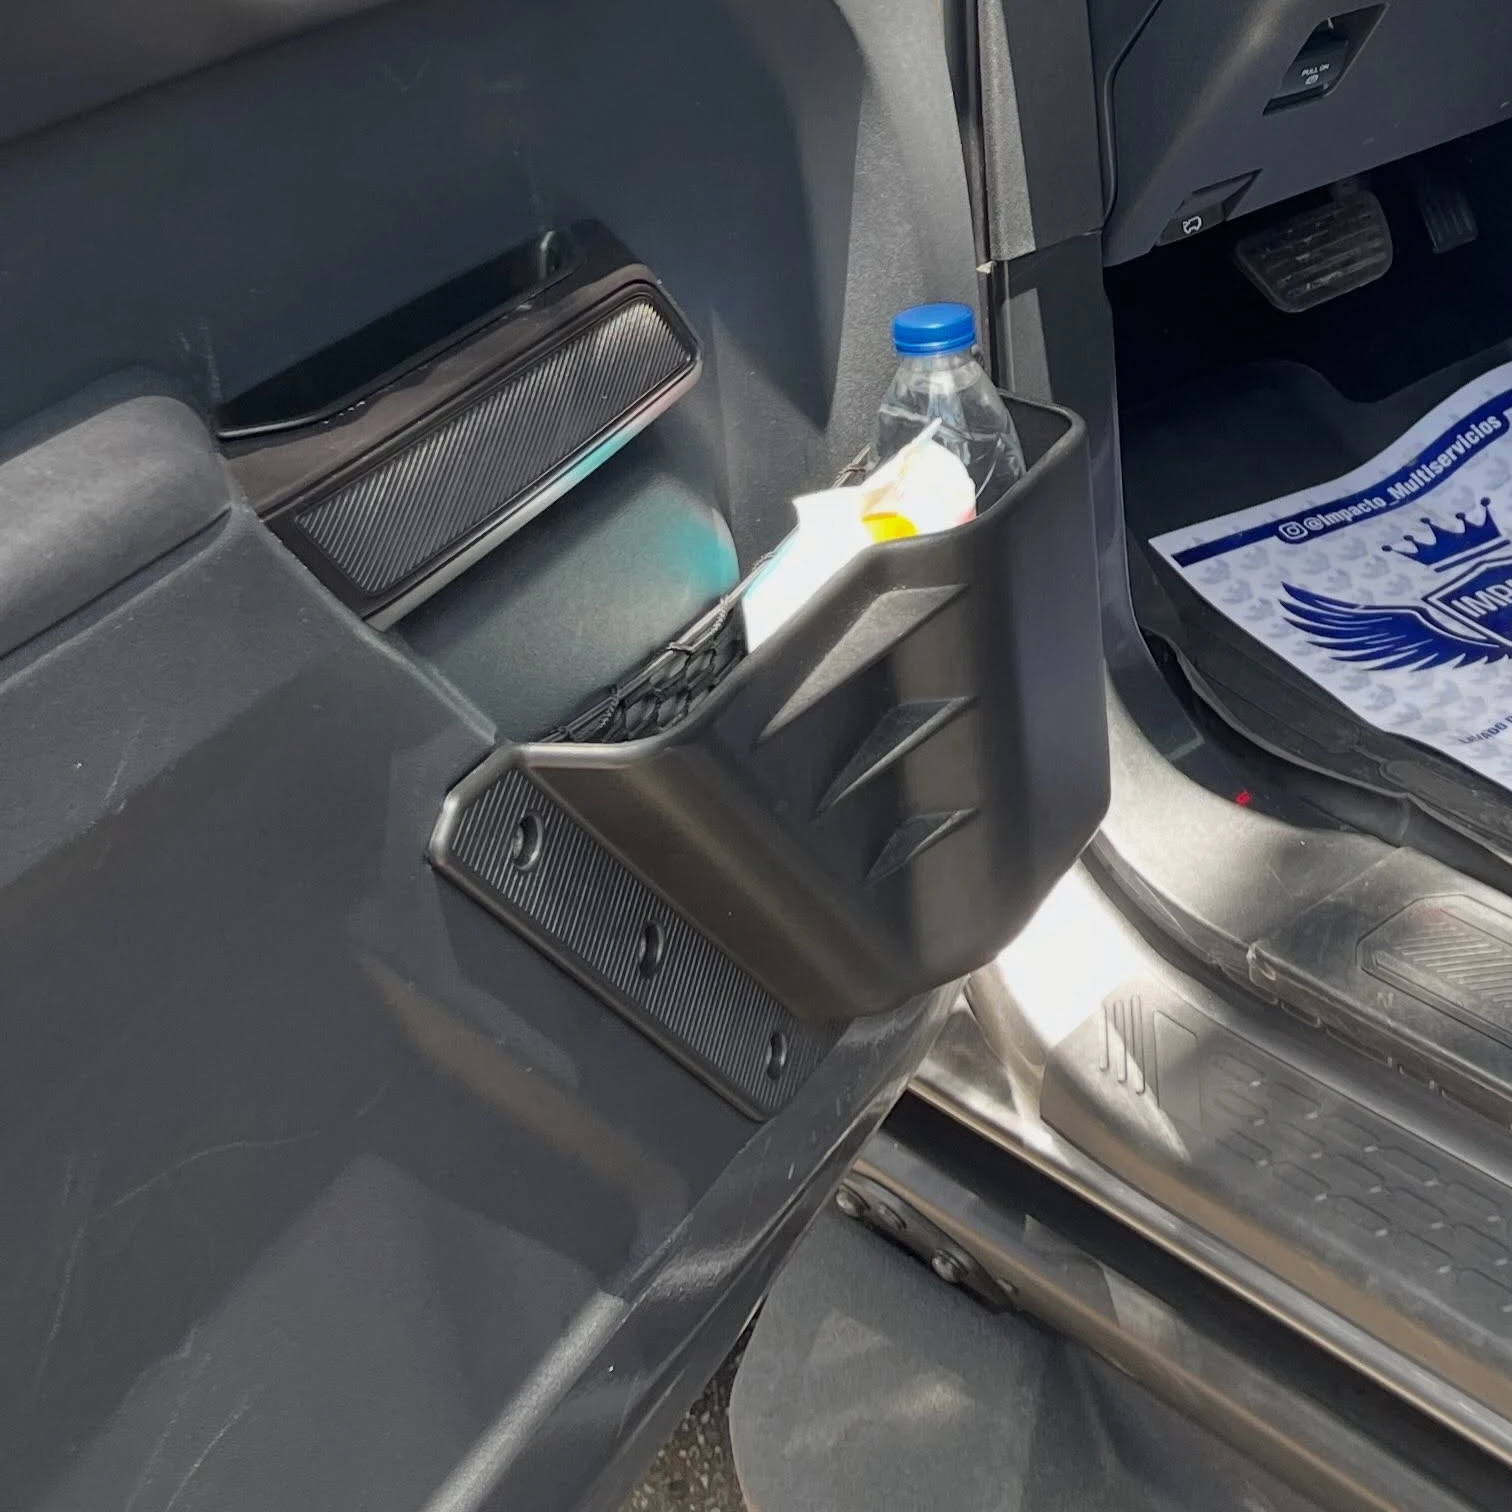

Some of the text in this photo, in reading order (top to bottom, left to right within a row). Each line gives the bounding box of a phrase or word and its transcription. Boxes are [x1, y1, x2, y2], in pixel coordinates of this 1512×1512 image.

[1301, 63, 1330, 77] PULL ON
[1303, 414, 1503, 531] @Impacto_Multiservicios
[1457, 722, 1507, 745] LAVADO
